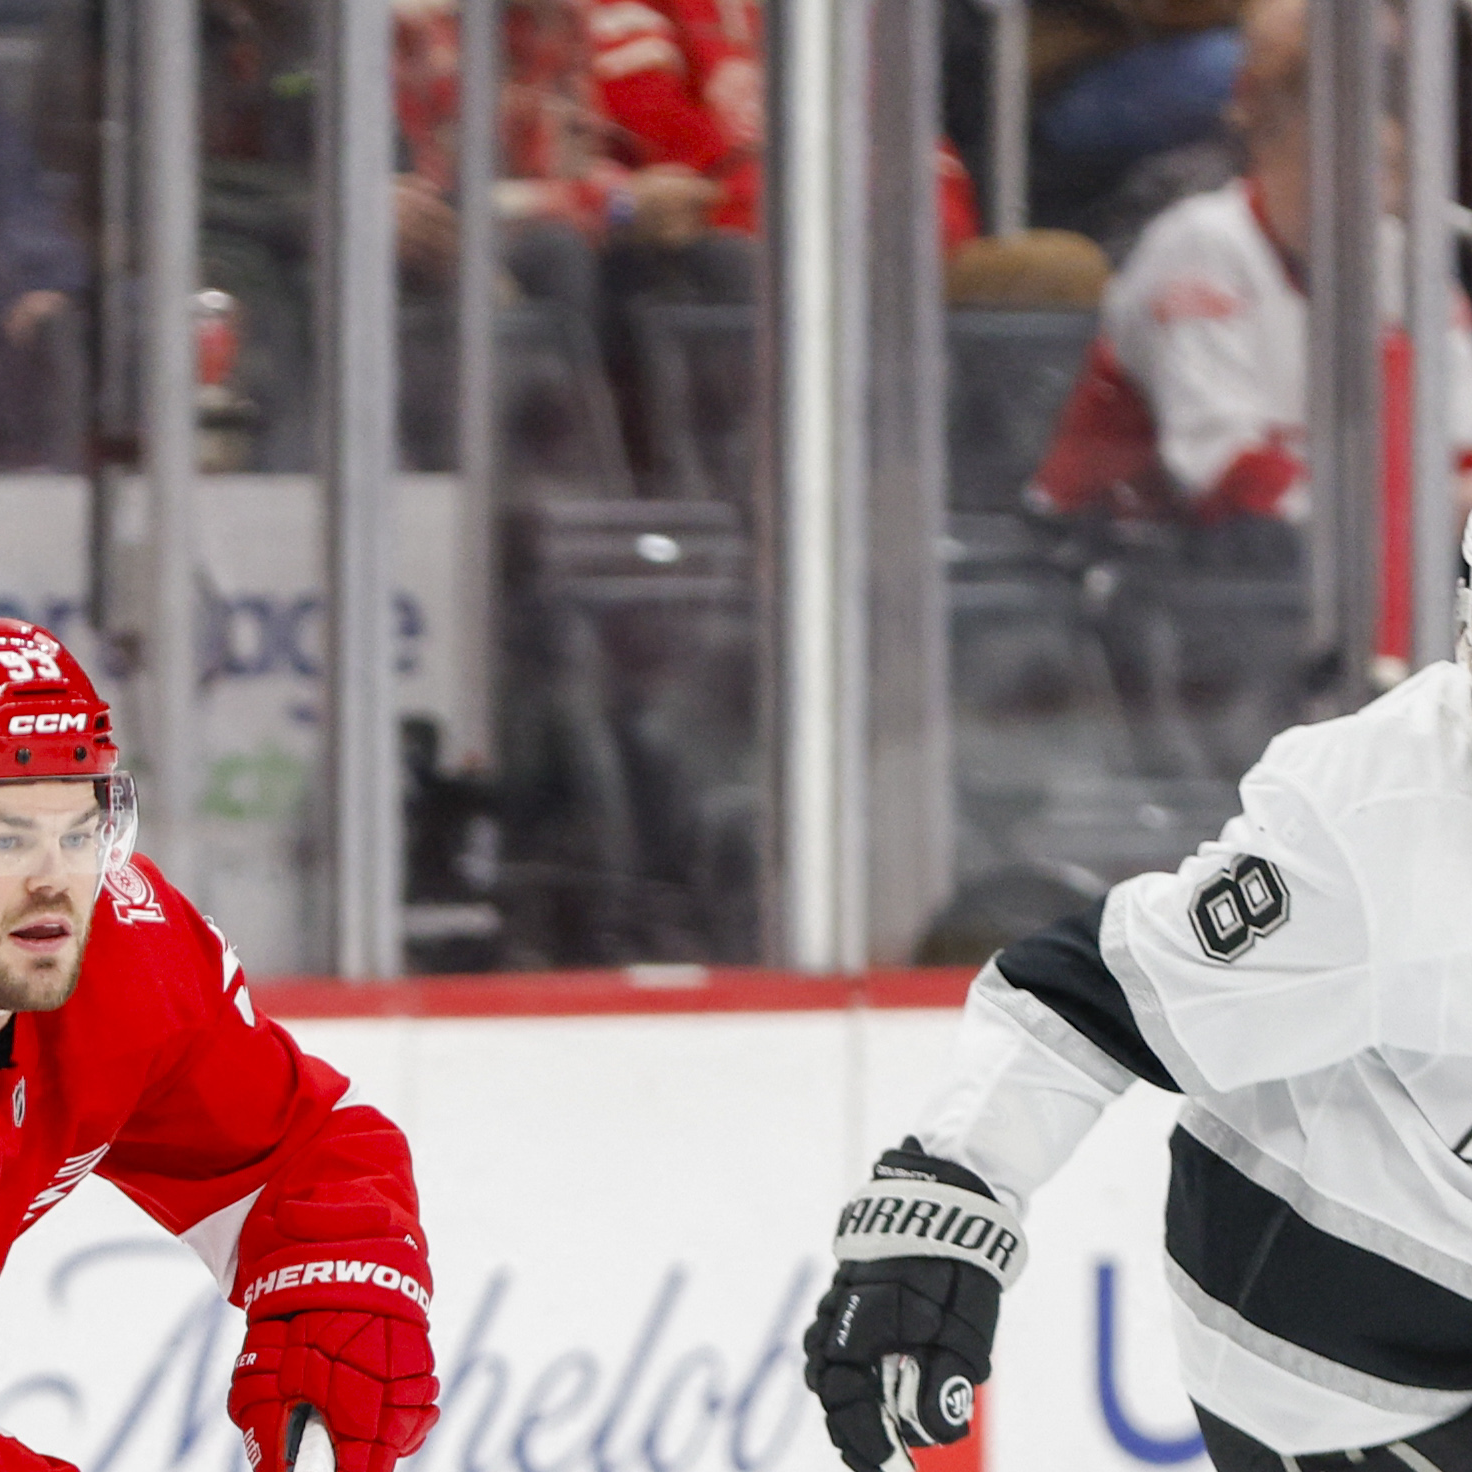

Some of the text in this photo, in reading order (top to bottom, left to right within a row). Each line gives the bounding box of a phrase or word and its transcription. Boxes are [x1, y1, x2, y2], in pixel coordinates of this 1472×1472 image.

[9, 713, 86, 735] CCM
[1187, 852, 1291, 963] 8
[837, 1197, 1019, 1272] ARRIOR
[243, 1259, 430, 1315] SHERWOOD
